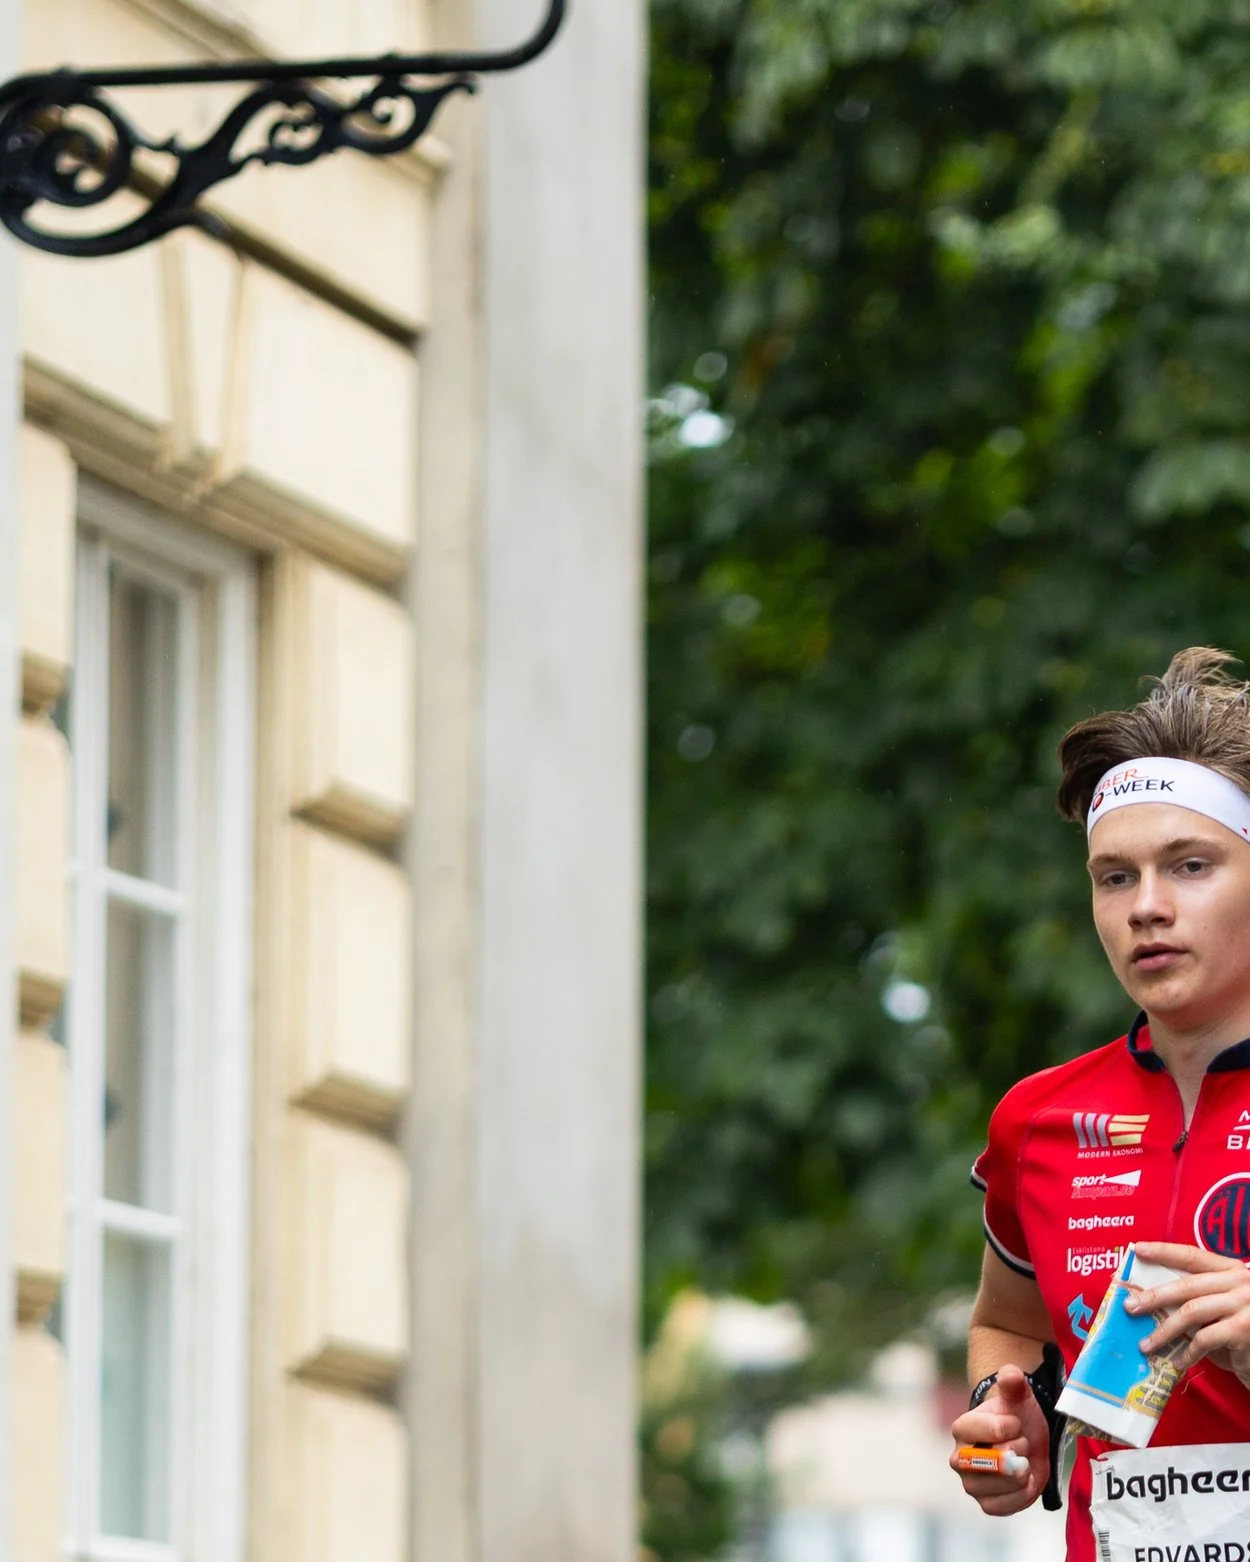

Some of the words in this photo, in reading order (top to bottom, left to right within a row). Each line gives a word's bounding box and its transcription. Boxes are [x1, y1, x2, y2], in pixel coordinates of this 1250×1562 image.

[1077, 1150, 1111, 1159] MODERN
[1112, 1147, 1143, 1157] EKONOMI
[1071, 1173, 1107, 1189] sport
[1067, 1214, 1135, 1231] bagheera
